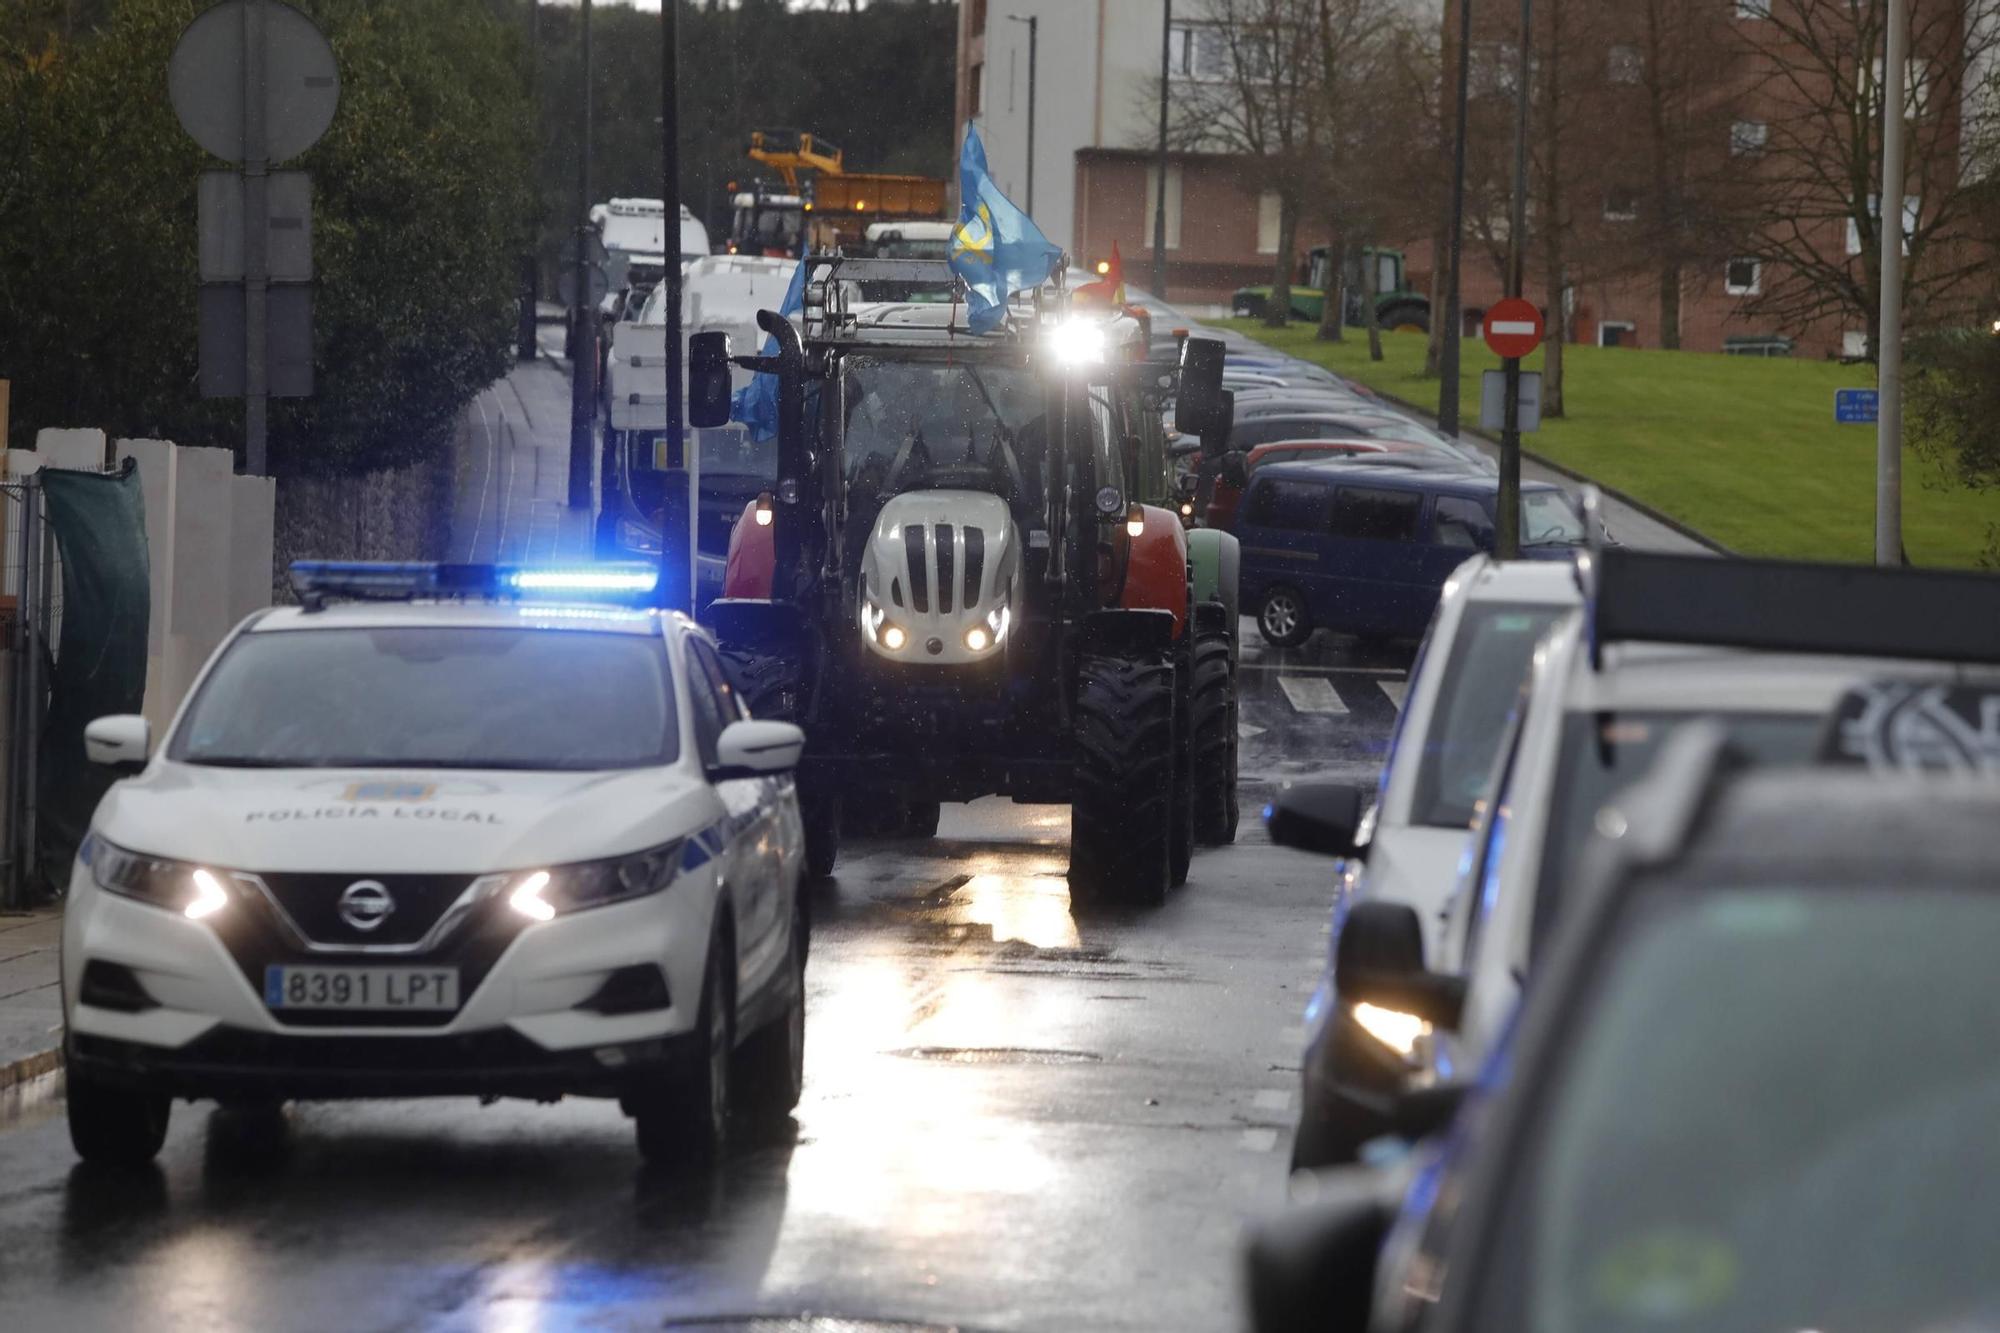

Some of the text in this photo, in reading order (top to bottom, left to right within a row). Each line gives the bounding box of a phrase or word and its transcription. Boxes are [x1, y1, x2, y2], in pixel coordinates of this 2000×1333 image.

[394, 806, 503, 824] LOCAL
[289, 972, 369, 1004] 8391
[385, 974, 449, 1006] LPT
